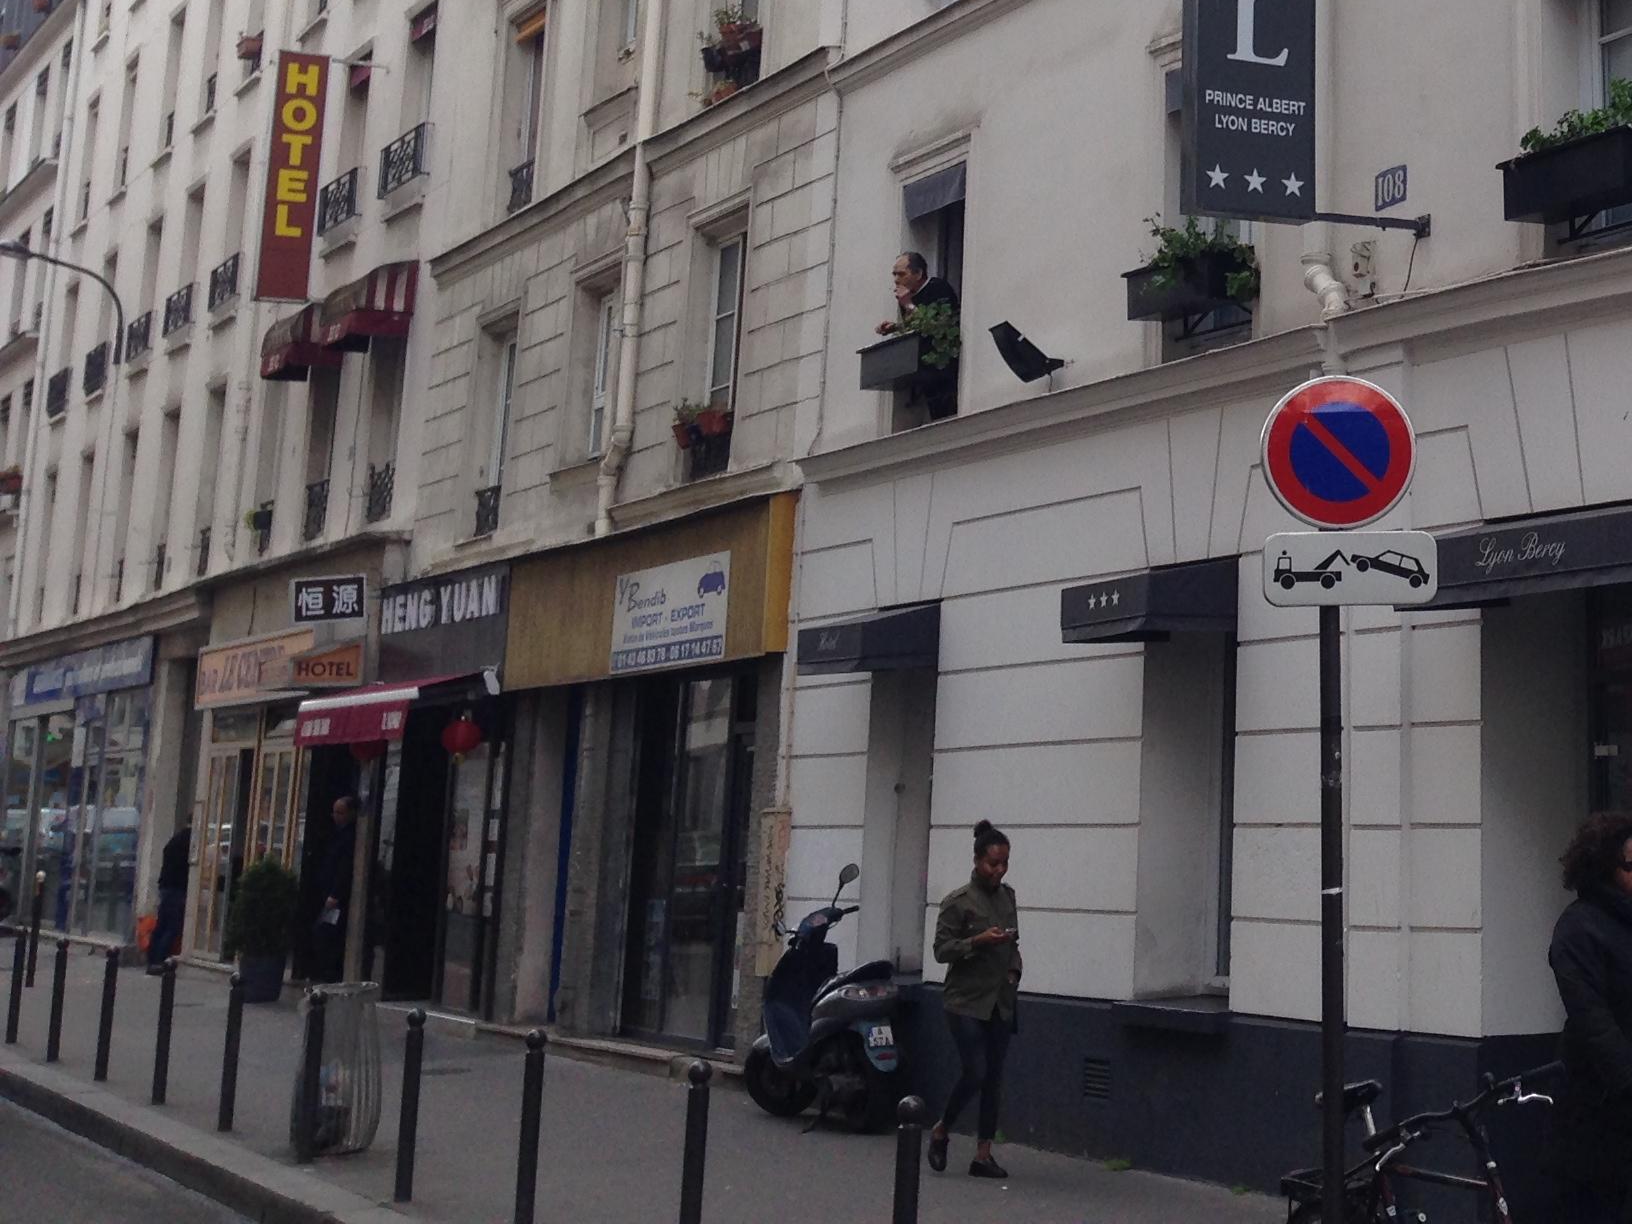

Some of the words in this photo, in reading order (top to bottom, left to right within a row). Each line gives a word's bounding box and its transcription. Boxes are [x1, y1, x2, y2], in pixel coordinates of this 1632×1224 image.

[1205, 89, 1254, 110] PRINCE
[1257, 97, 1306, 116] ALBERT
[1215, 113, 1248, 132] LYON
[1251, 119, 1296, 137] BERCY
[275, 62, 320, 237] HOTEL
[1377, 170, 1404, 206] 108
[1475, 537, 1514, 575] Lyon
[1518, 531, 1566, 566] Bercy
[380, 588, 436, 634] HENG
[440, 575, 499, 625] YUAN
[632, 612, 663, 629] IMPORT
[671, 603, 706, 622] EXPORT
[296, 660, 354, 677] HOTEL
